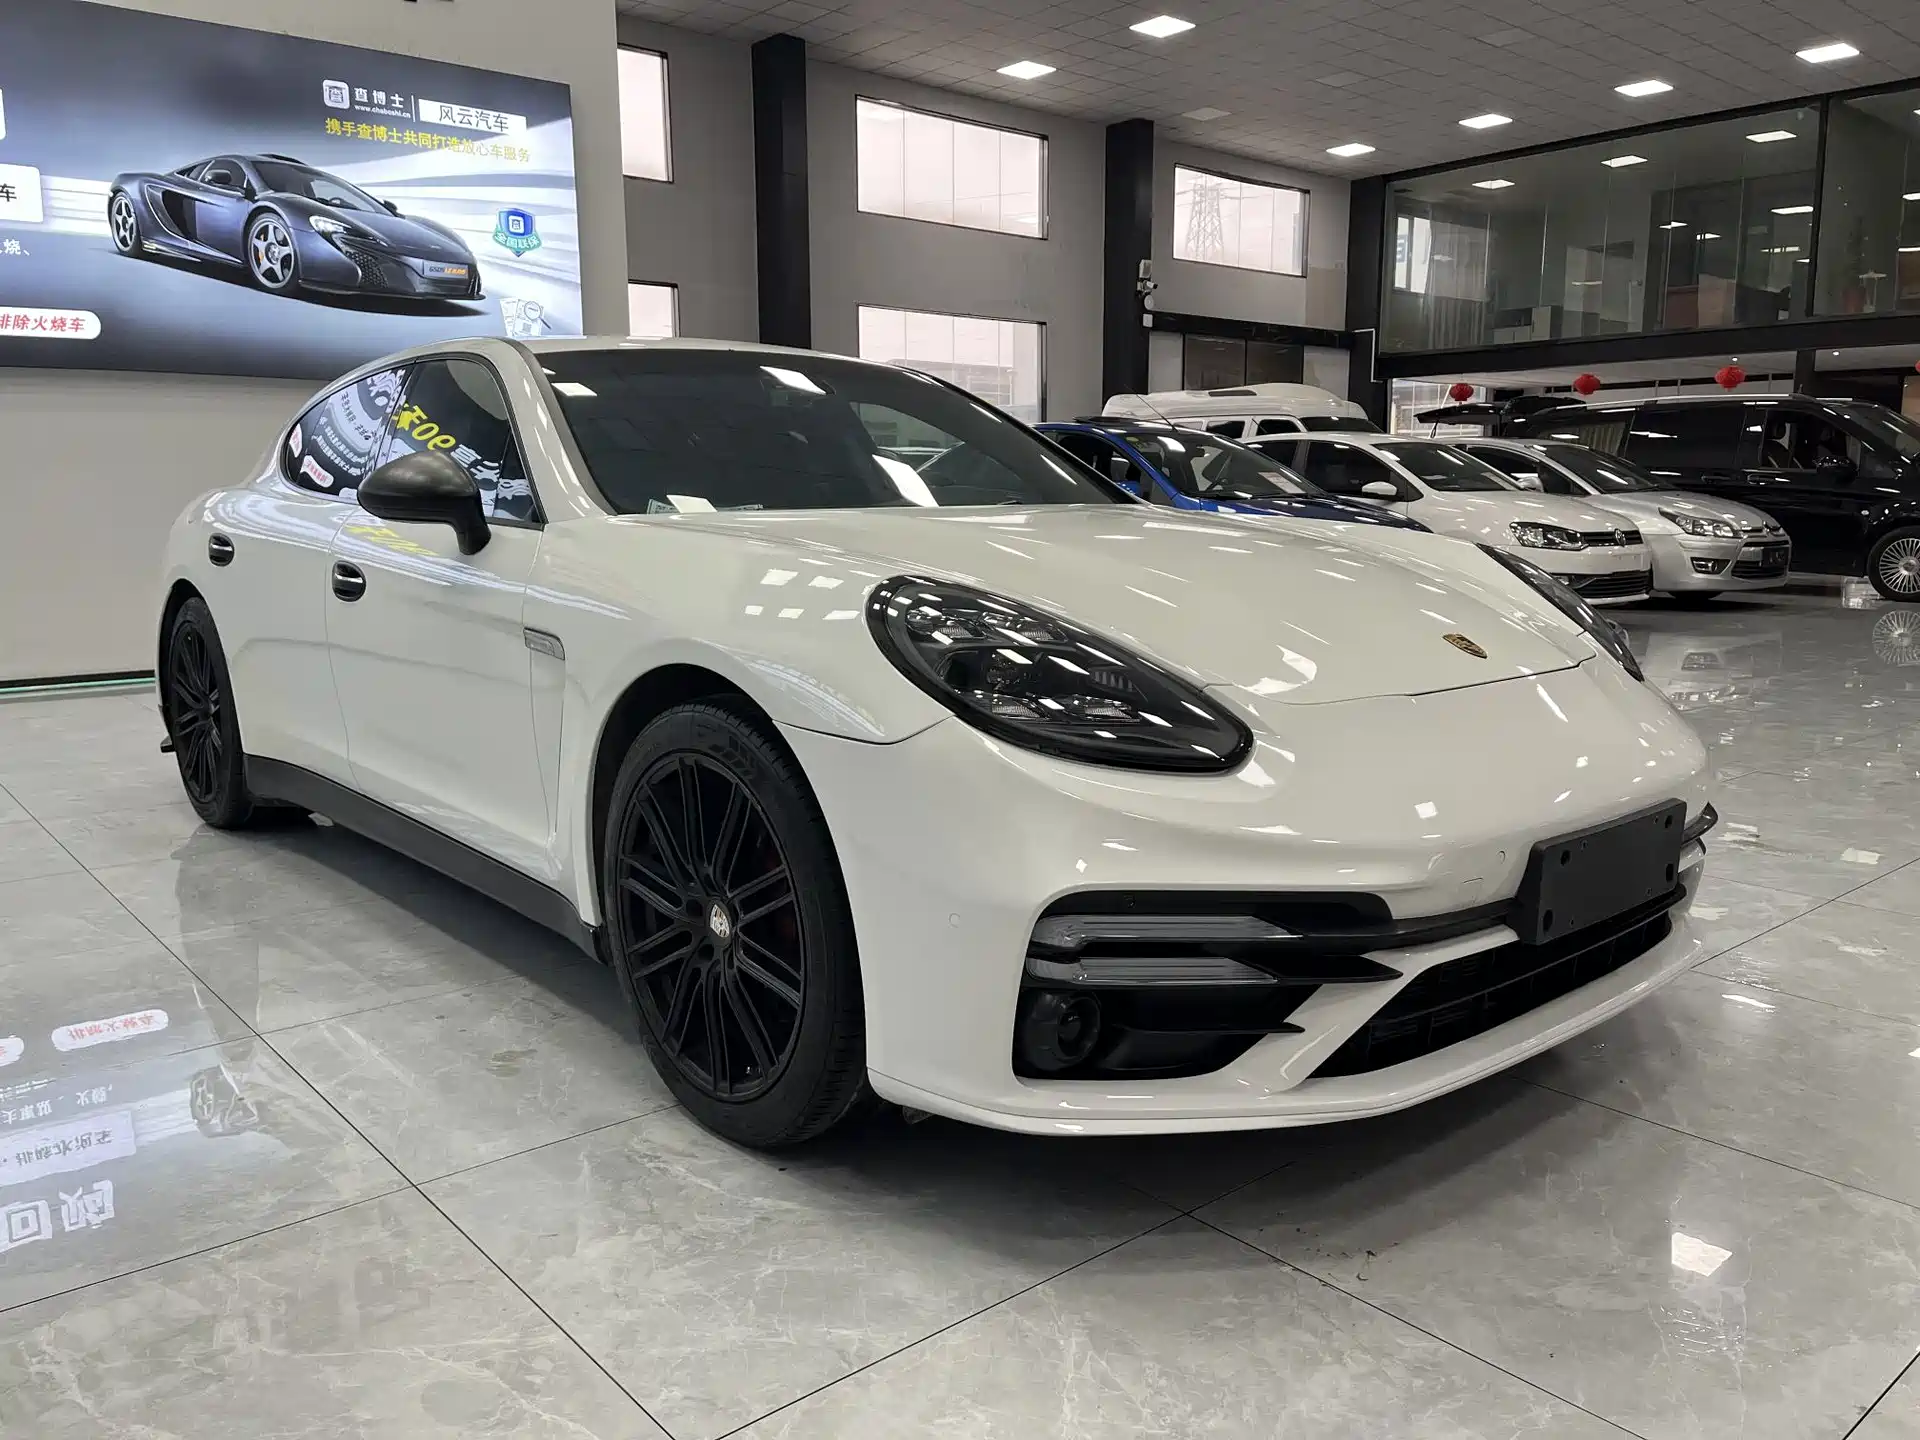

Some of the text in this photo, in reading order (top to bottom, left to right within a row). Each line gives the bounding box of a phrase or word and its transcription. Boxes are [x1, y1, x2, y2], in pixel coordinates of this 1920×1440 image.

[354, 87, 405, 109] 查博士
[439, 104, 509, 132] 风云汽车
[325, 117, 531, 163] 携手查博士共同打造放心车服务
